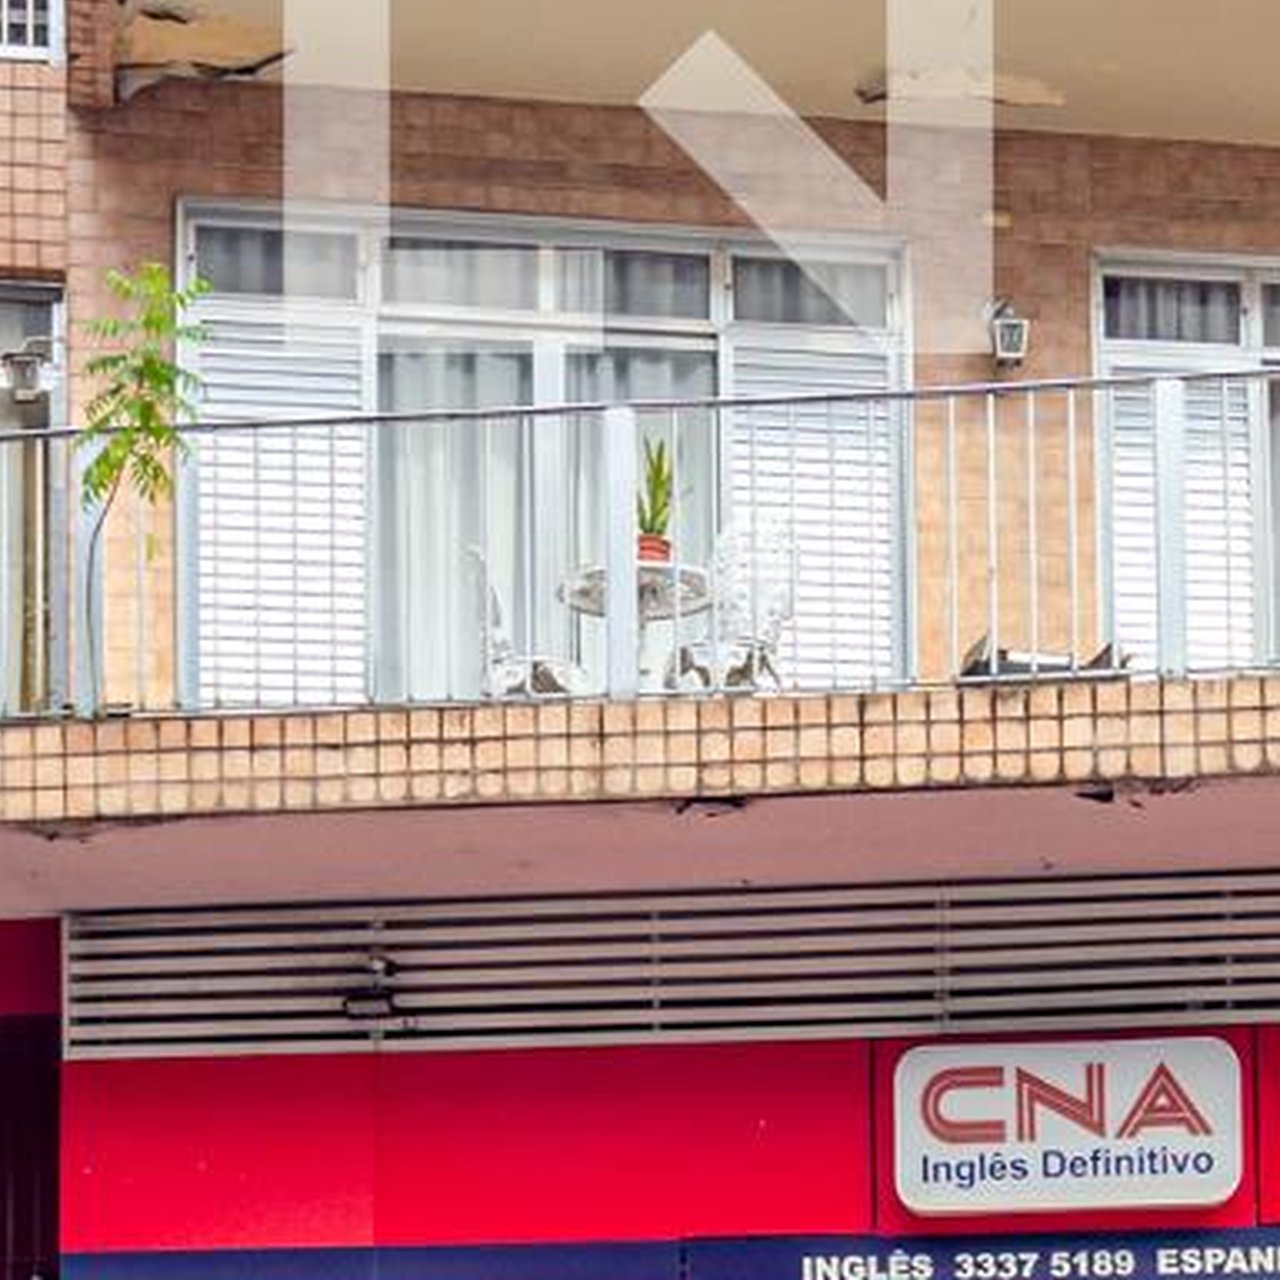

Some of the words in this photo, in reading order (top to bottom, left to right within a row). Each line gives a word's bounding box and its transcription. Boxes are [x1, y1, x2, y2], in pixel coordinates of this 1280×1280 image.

[921, 1060, 1214, 1144] CNA
[922, 1152, 1029, 1189] Inglês
[1042, 1144, 1215, 1179] Definitivo
[801, 1248, 934, 1280] INGLÊS
[954, 1252, 1038, 1278] 3337
[1049, 1249, 1136, 1277] 5189
